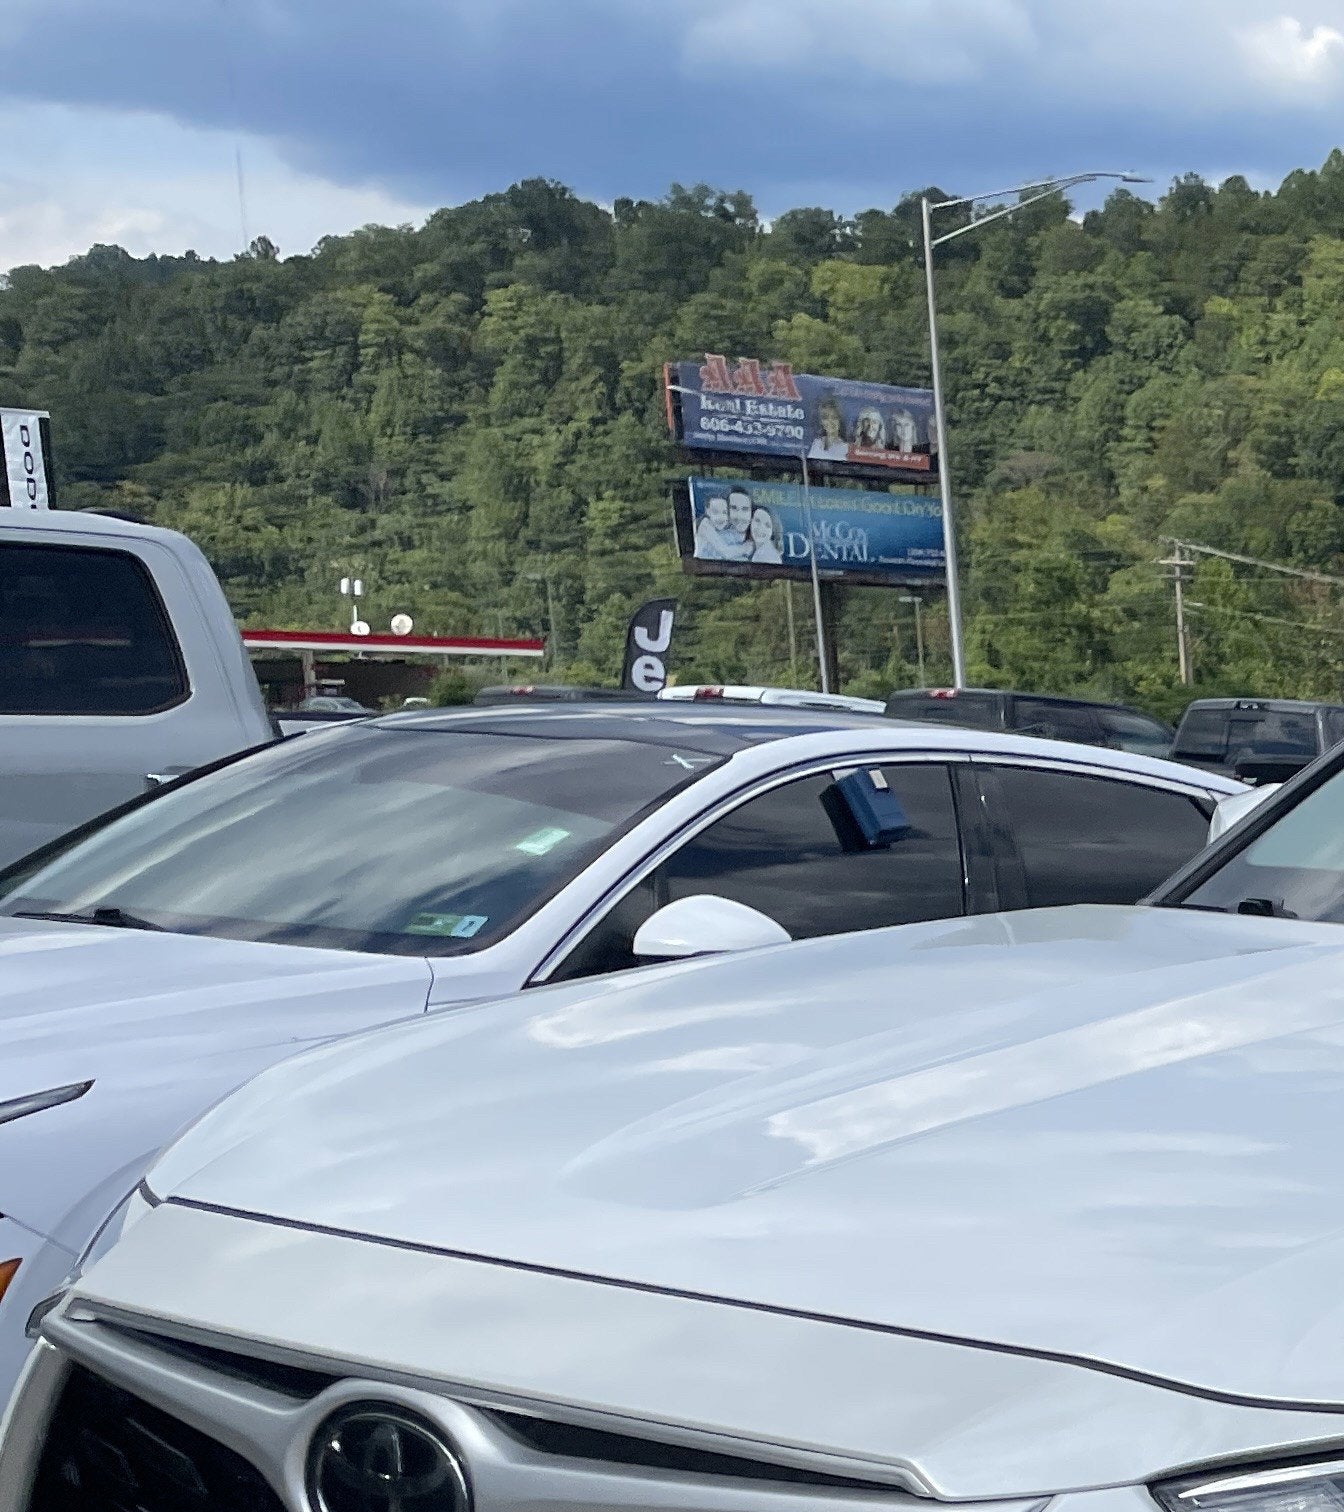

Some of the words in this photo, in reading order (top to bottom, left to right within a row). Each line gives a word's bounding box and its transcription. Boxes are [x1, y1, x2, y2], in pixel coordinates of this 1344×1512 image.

[745, 400, 805, 420] Estate
[20, 425, 37, 509] DOD
[631, 609, 674, 692] Je
